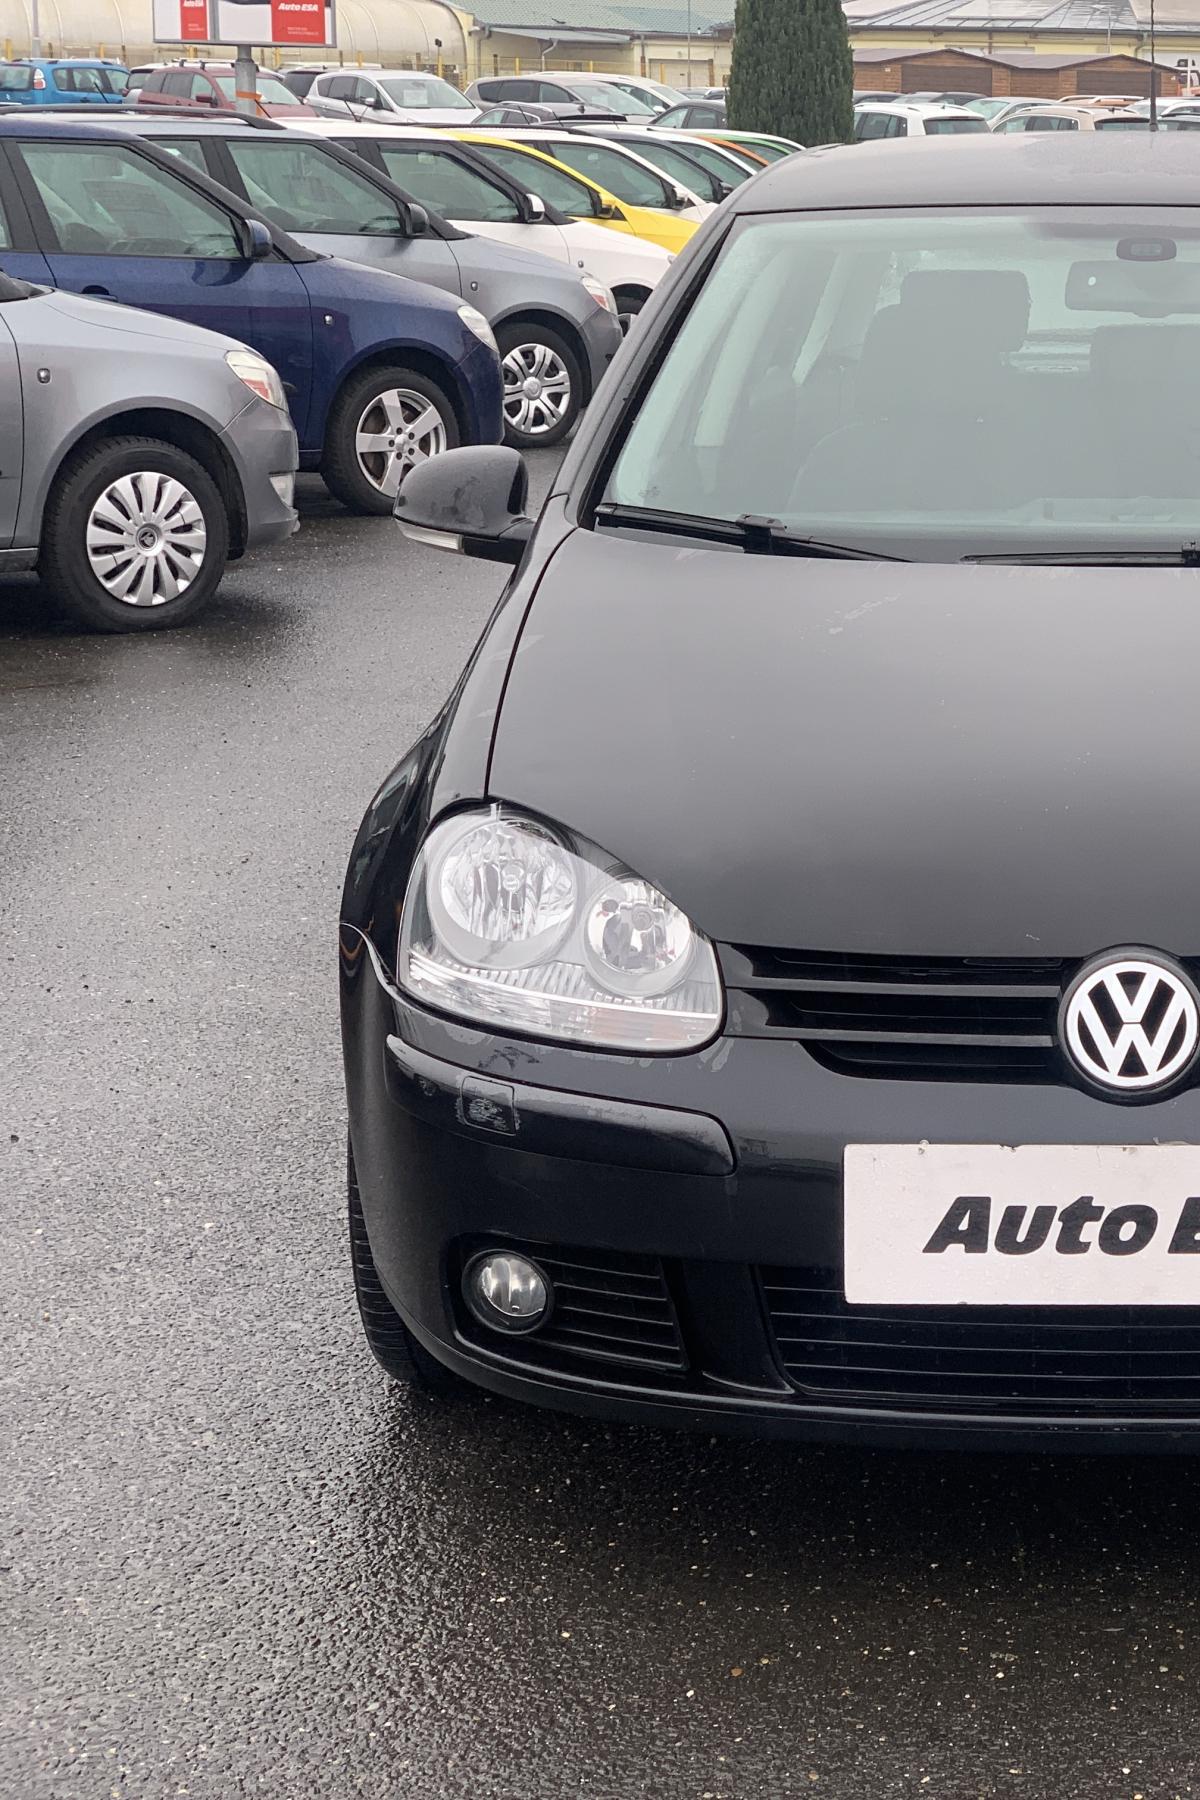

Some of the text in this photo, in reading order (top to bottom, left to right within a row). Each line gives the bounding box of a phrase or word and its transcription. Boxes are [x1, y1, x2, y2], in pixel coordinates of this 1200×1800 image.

[278, 2, 301, 11] Auto
[1066, 961, 1198, 1087] VW
[922, 1195, 1159, 1256] Auto
